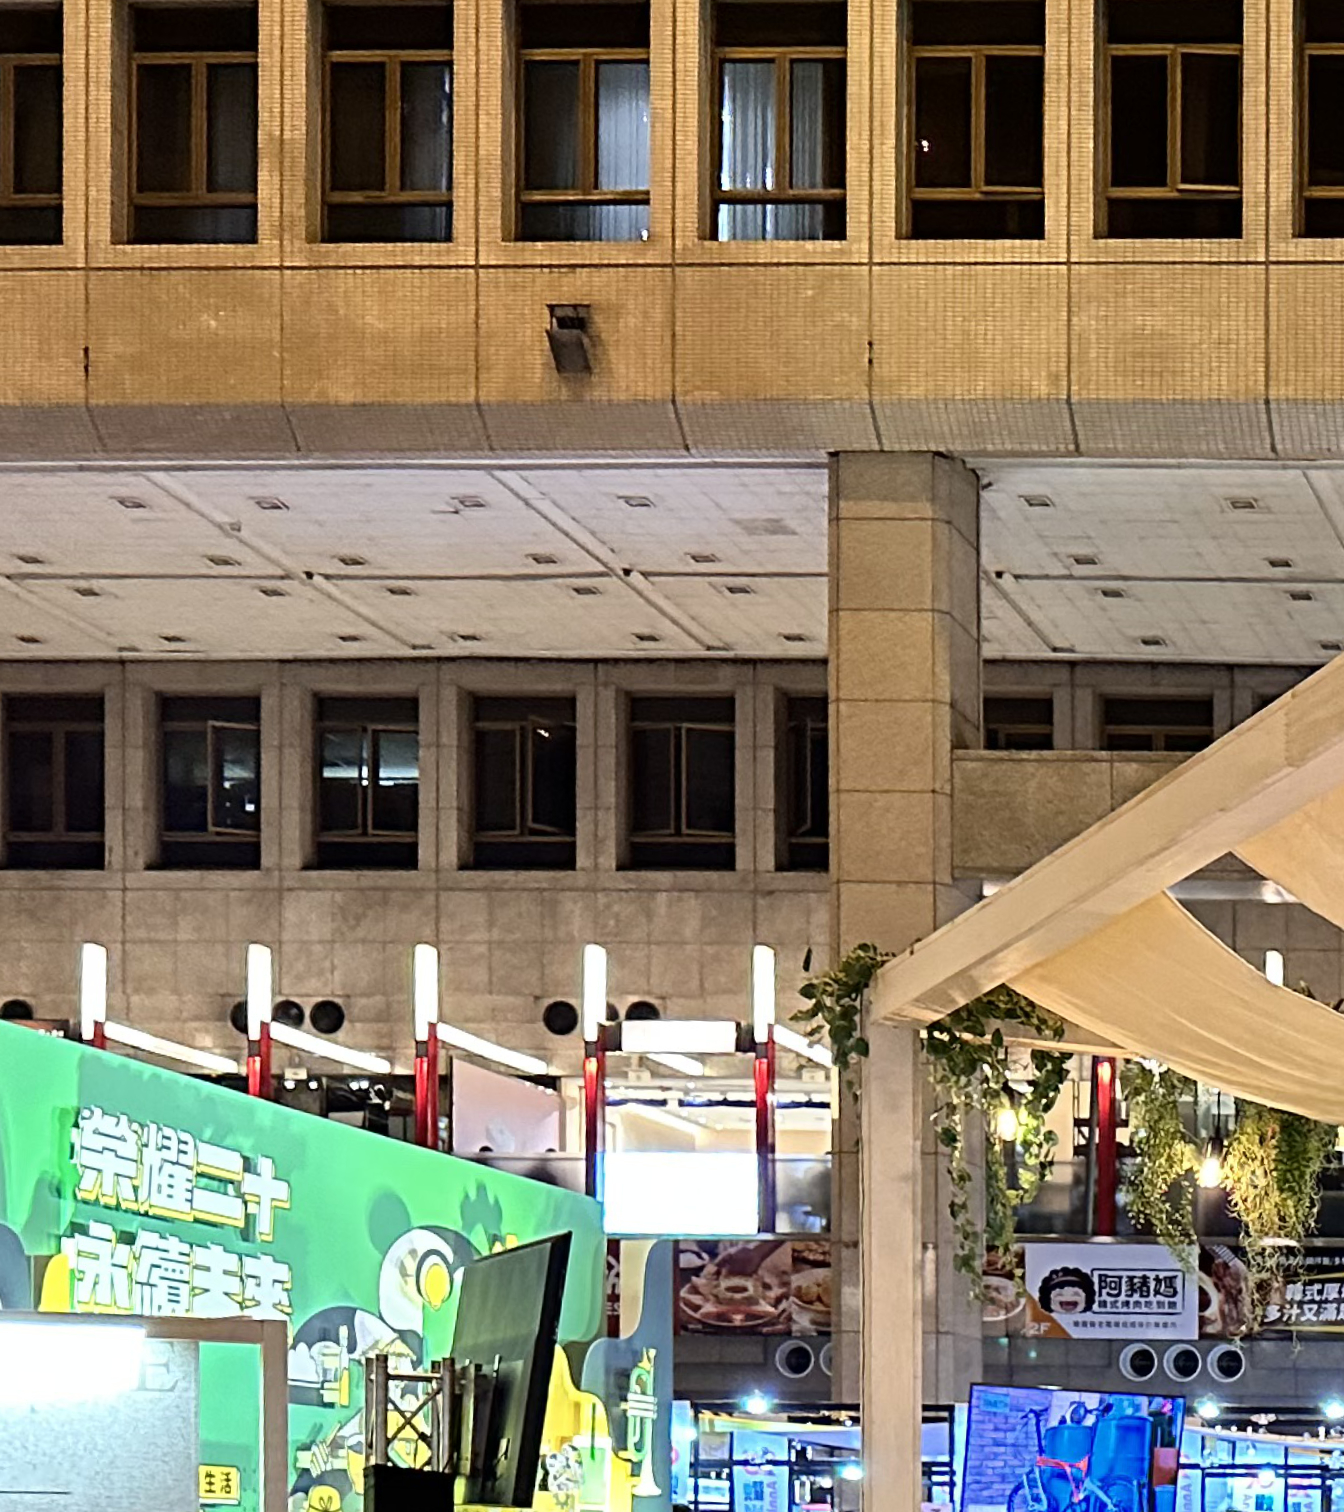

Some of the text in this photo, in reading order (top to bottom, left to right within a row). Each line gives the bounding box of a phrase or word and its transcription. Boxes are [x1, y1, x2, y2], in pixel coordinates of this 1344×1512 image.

[78, 1106, 291, 1242] 榮耀二十
[1097, 1273, 1179, 1299] 阿豬媽
[203, 1470, 233, 1494] 生活
